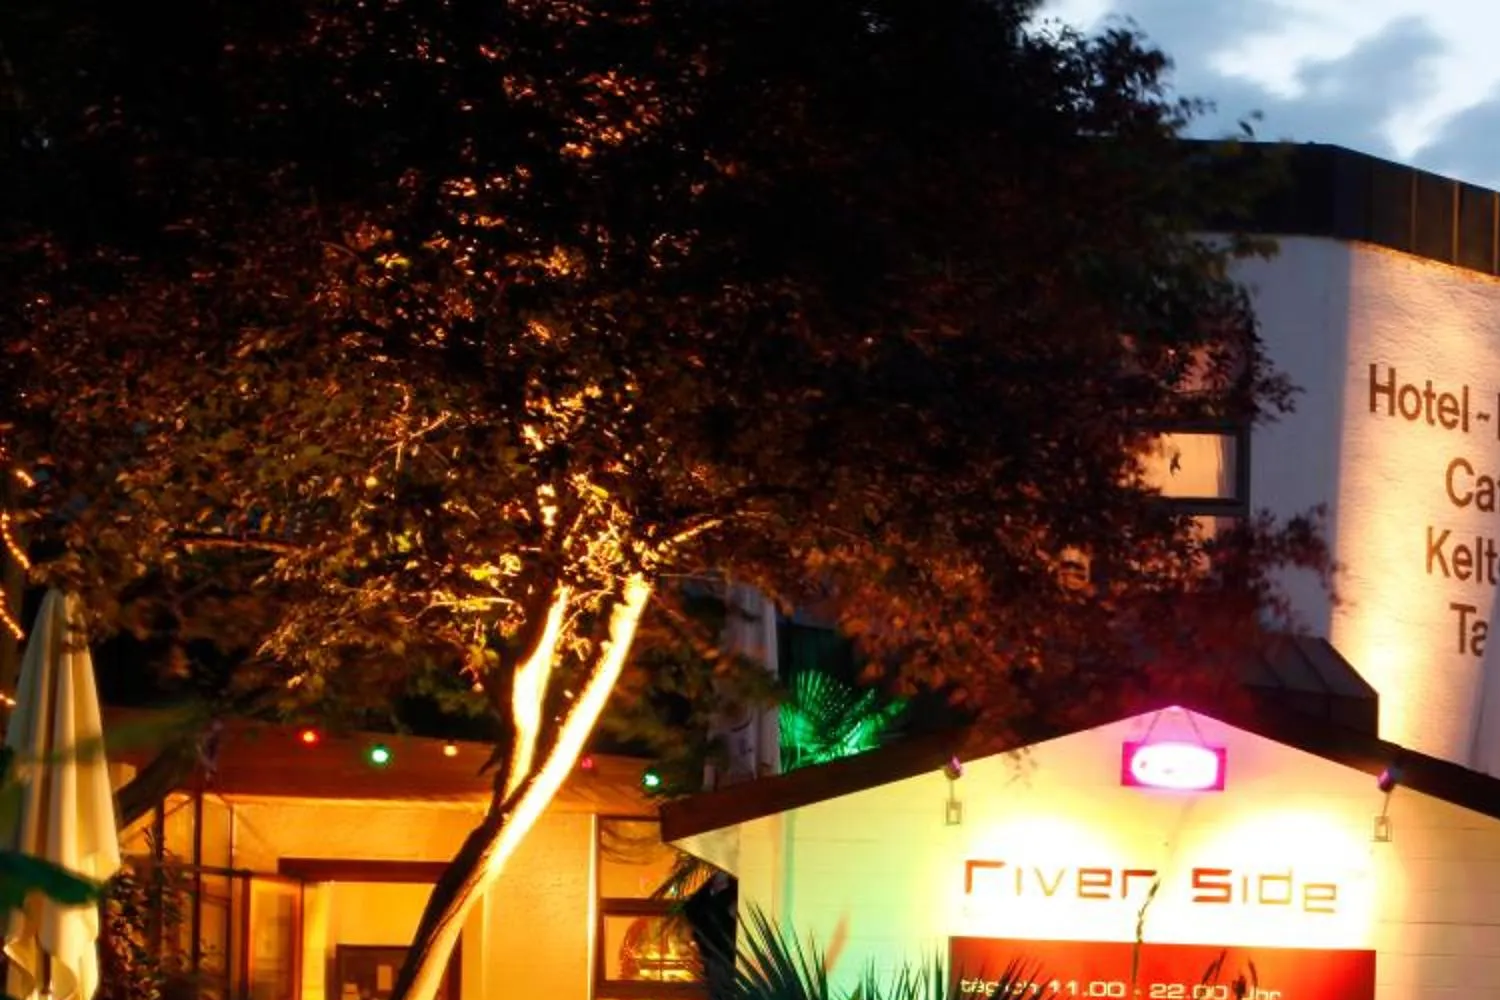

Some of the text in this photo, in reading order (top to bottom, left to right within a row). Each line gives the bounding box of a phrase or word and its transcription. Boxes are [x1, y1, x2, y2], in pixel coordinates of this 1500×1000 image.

[960, 978, 1040, 998] tägch
[1048, 980, 1127, 998] 11.00
[1149, 983, 1229, 1000] 22.00
